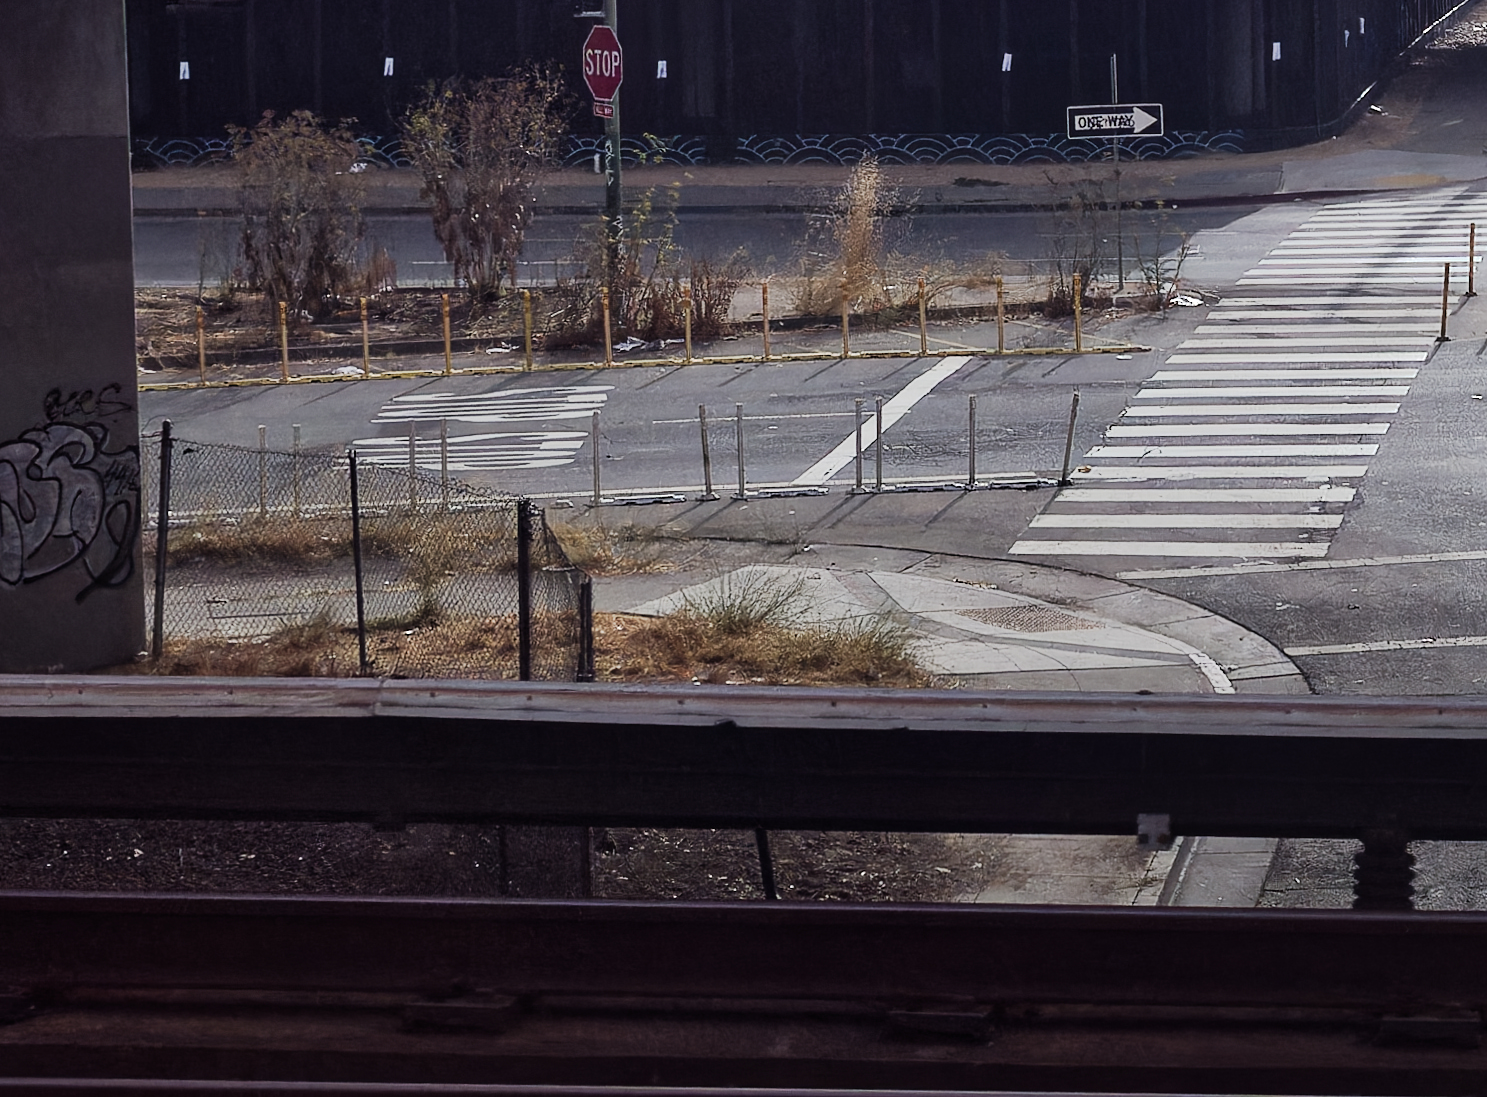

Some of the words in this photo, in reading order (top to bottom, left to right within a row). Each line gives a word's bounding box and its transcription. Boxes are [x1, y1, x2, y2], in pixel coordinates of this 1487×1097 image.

[585, 48, 620, 77] STOP
[1078, 116, 1103, 129] ONE
[1107, 114, 1134, 128] WAY
